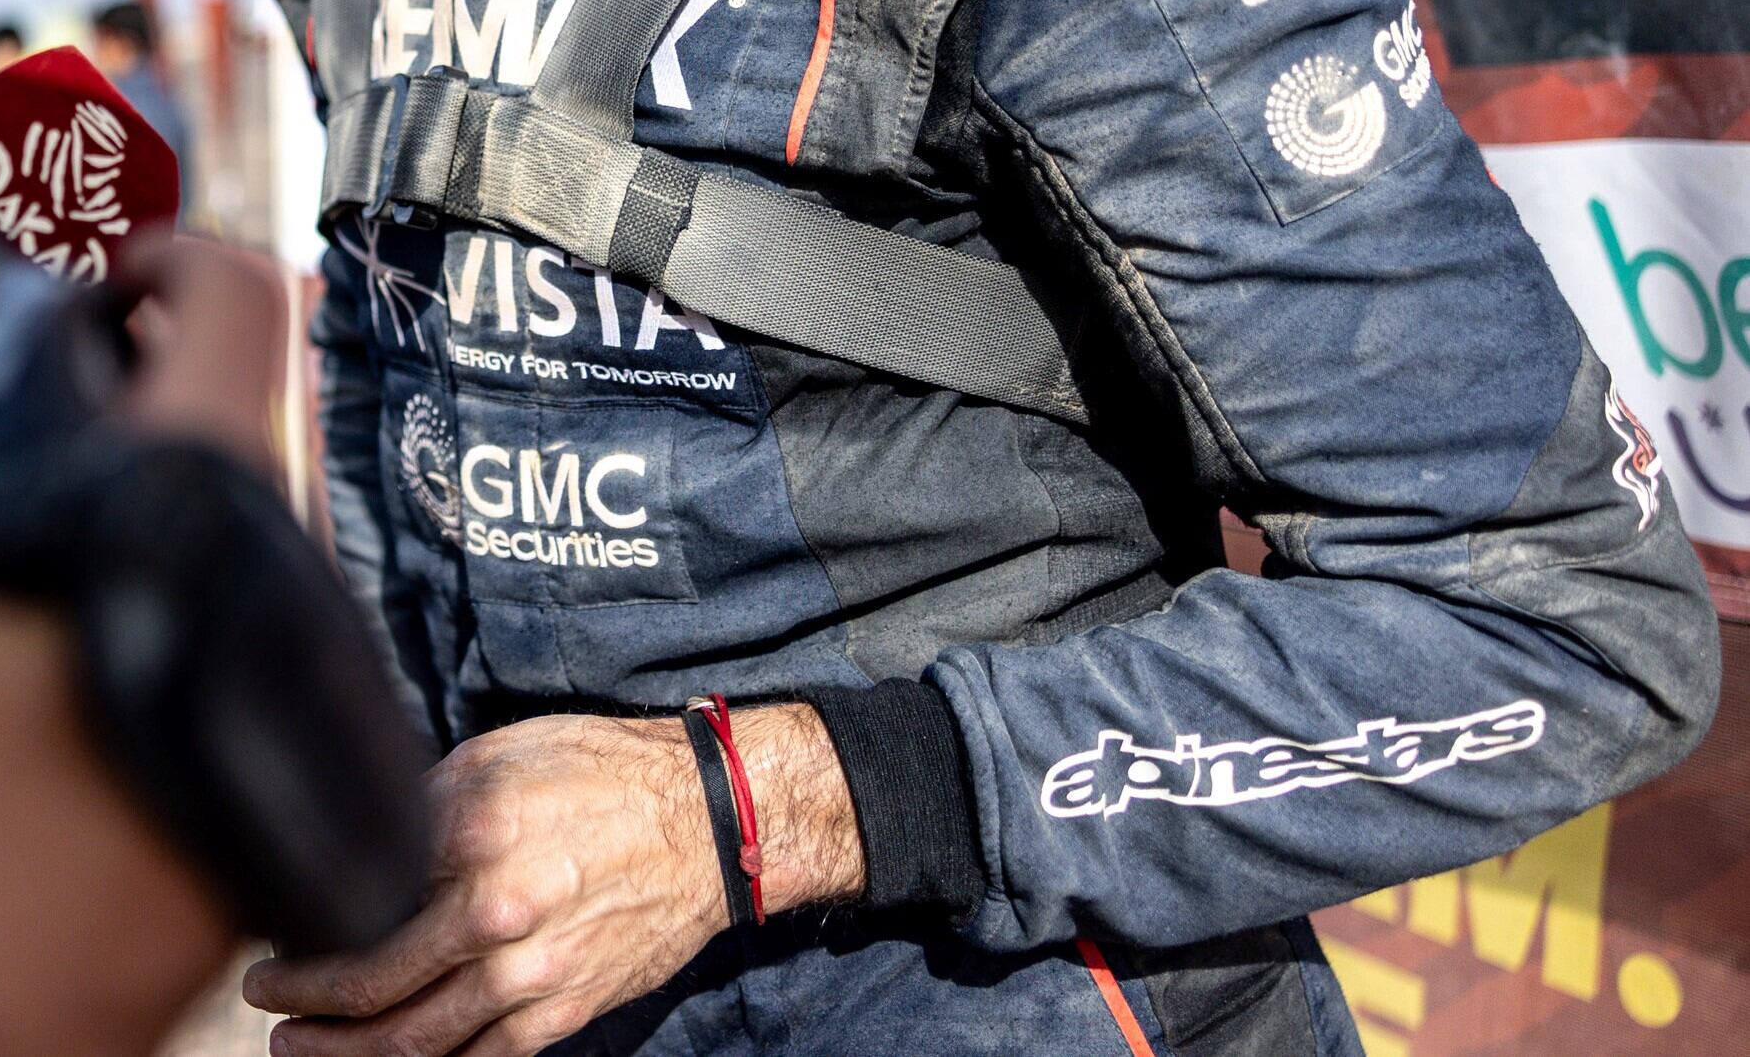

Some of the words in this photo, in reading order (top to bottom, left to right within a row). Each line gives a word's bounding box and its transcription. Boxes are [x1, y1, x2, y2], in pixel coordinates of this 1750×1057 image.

[446, 338, 515, 374] ERGY
[520, 355, 569, 380] FOR
[571, 361, 736, 390] TOMORROW
[460, 444, 647, 529] GMC
